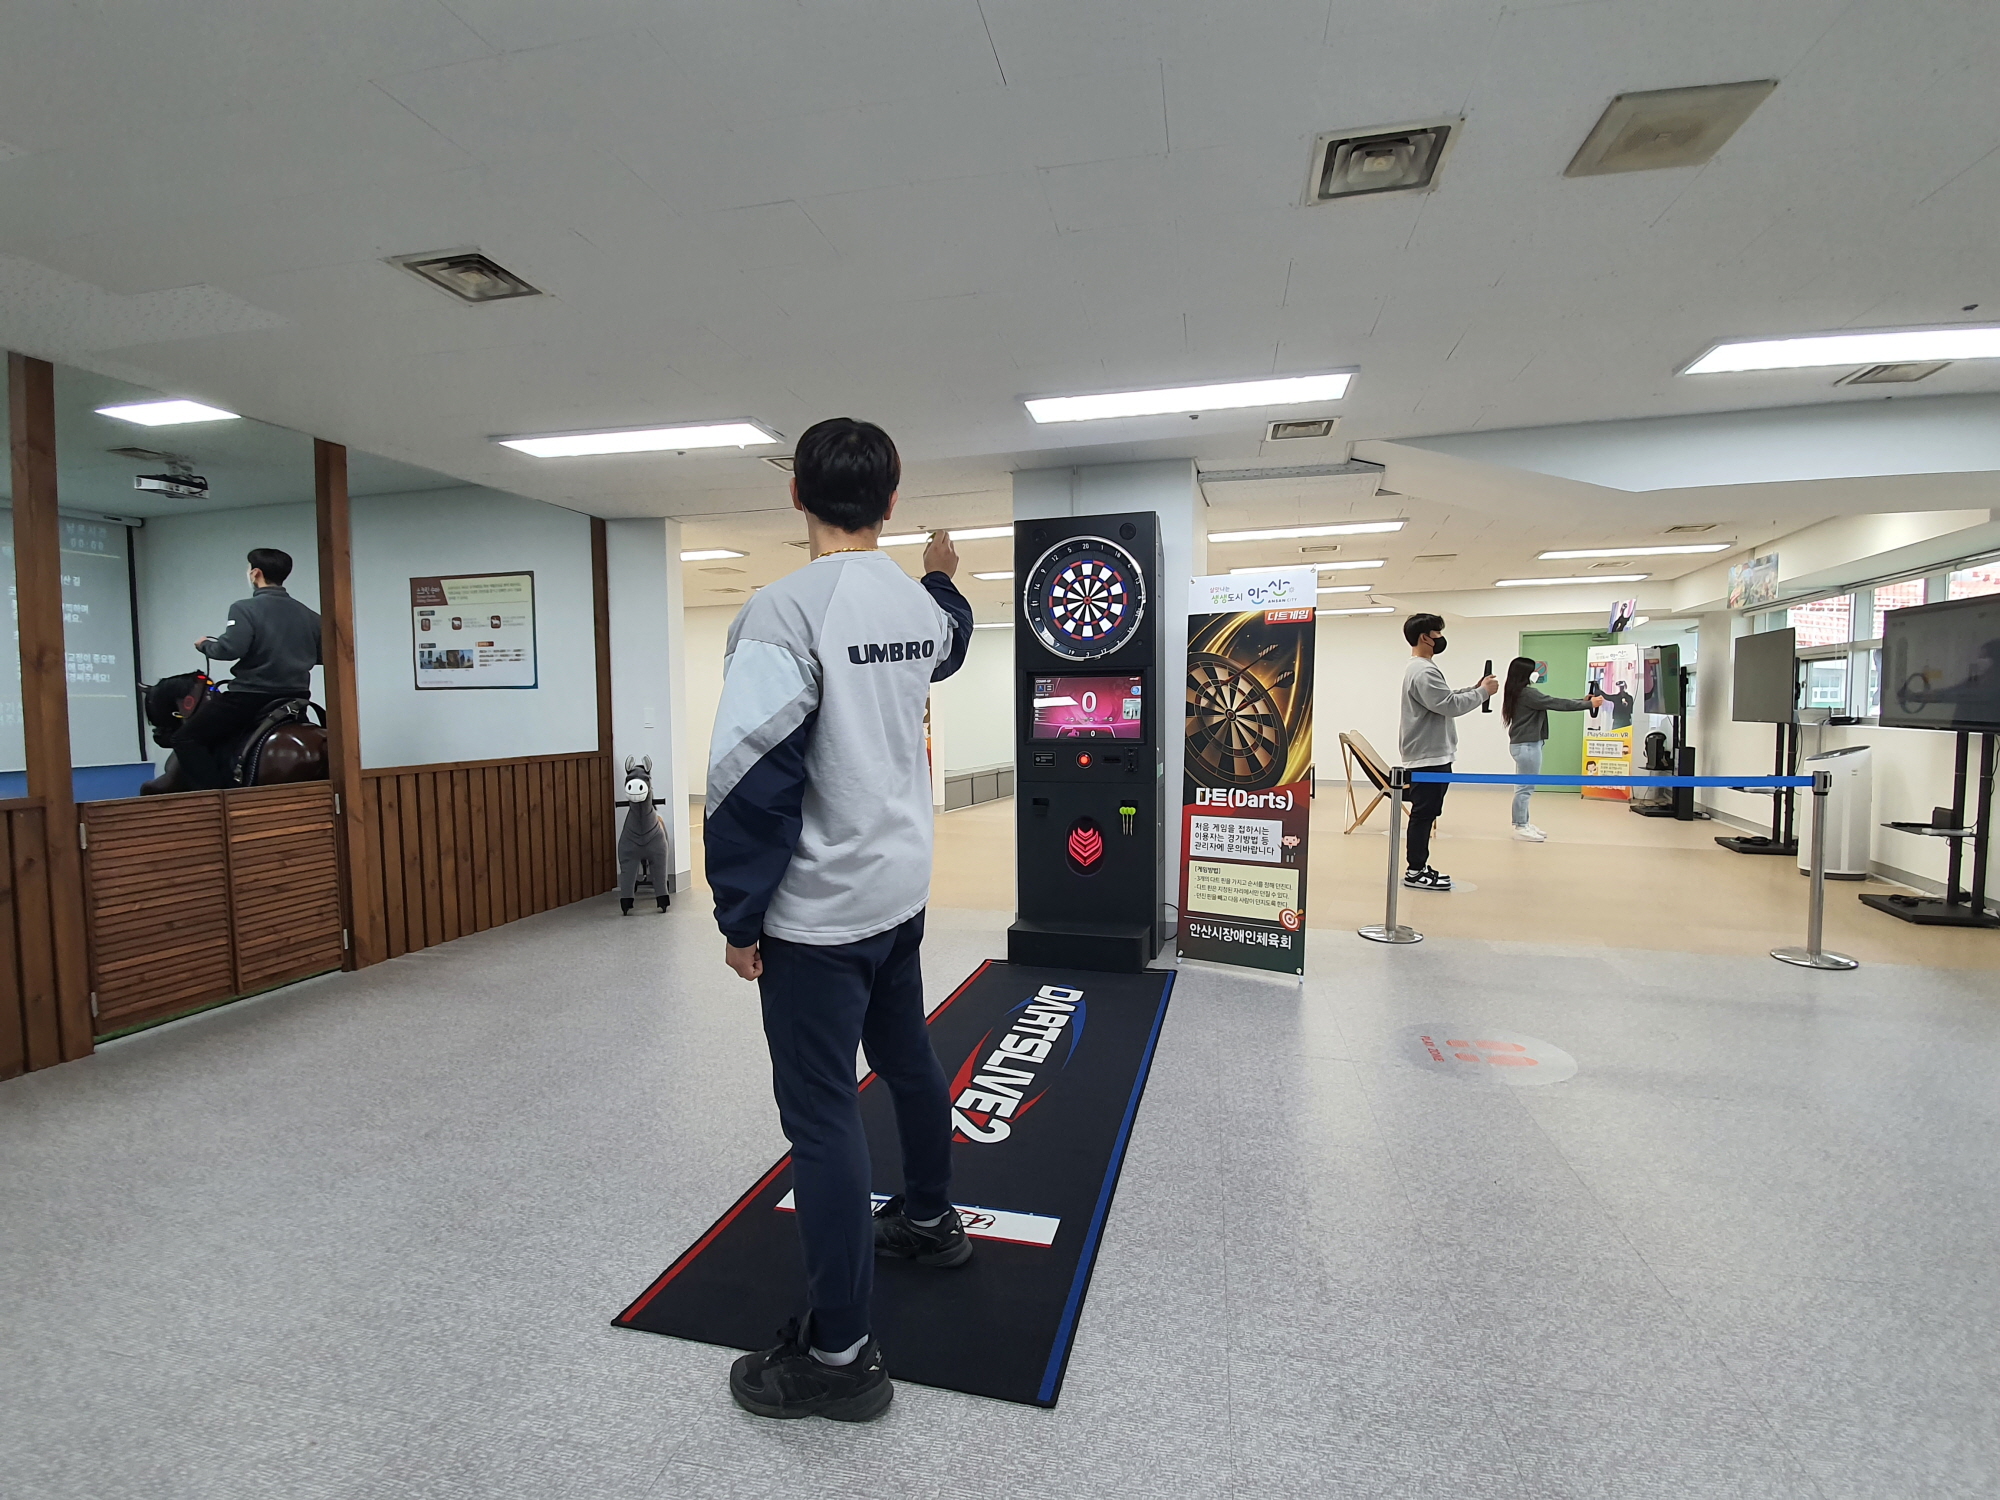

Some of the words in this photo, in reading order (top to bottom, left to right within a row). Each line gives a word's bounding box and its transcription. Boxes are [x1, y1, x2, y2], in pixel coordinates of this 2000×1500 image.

[1051, 554, 1059, 562] 12
[1211, 593, 1243, 605] 생생도시
[1267, 609, 1310, 621] 다트게임
[847, 639, 935, 665] UMBRO
[1081, 691, 1097, 713] 0
[1195, 787, 1294, 811] 다트(Darts)
[1194, 822, 1210, 832] 처음
[1212, 823, 1236, 833] 게임을
[1238, 825, 1270, 836] 접하시는
[1194, 831, 1225, 842] 이용자는
[1228, 834, 1259, 844] 경기방법
[1261, 836, 1269, 846] 등
[1194, 841, 1225, 852] 관리자에
[1227, 843, 1275, 856] 문의바랍니다
[1231, 878, 1247, 886] 가지고
[1189, 923, 1292, 950] 안산시장애인체육회
[951, 984, 1085, 1144] DARTSLIVE2
